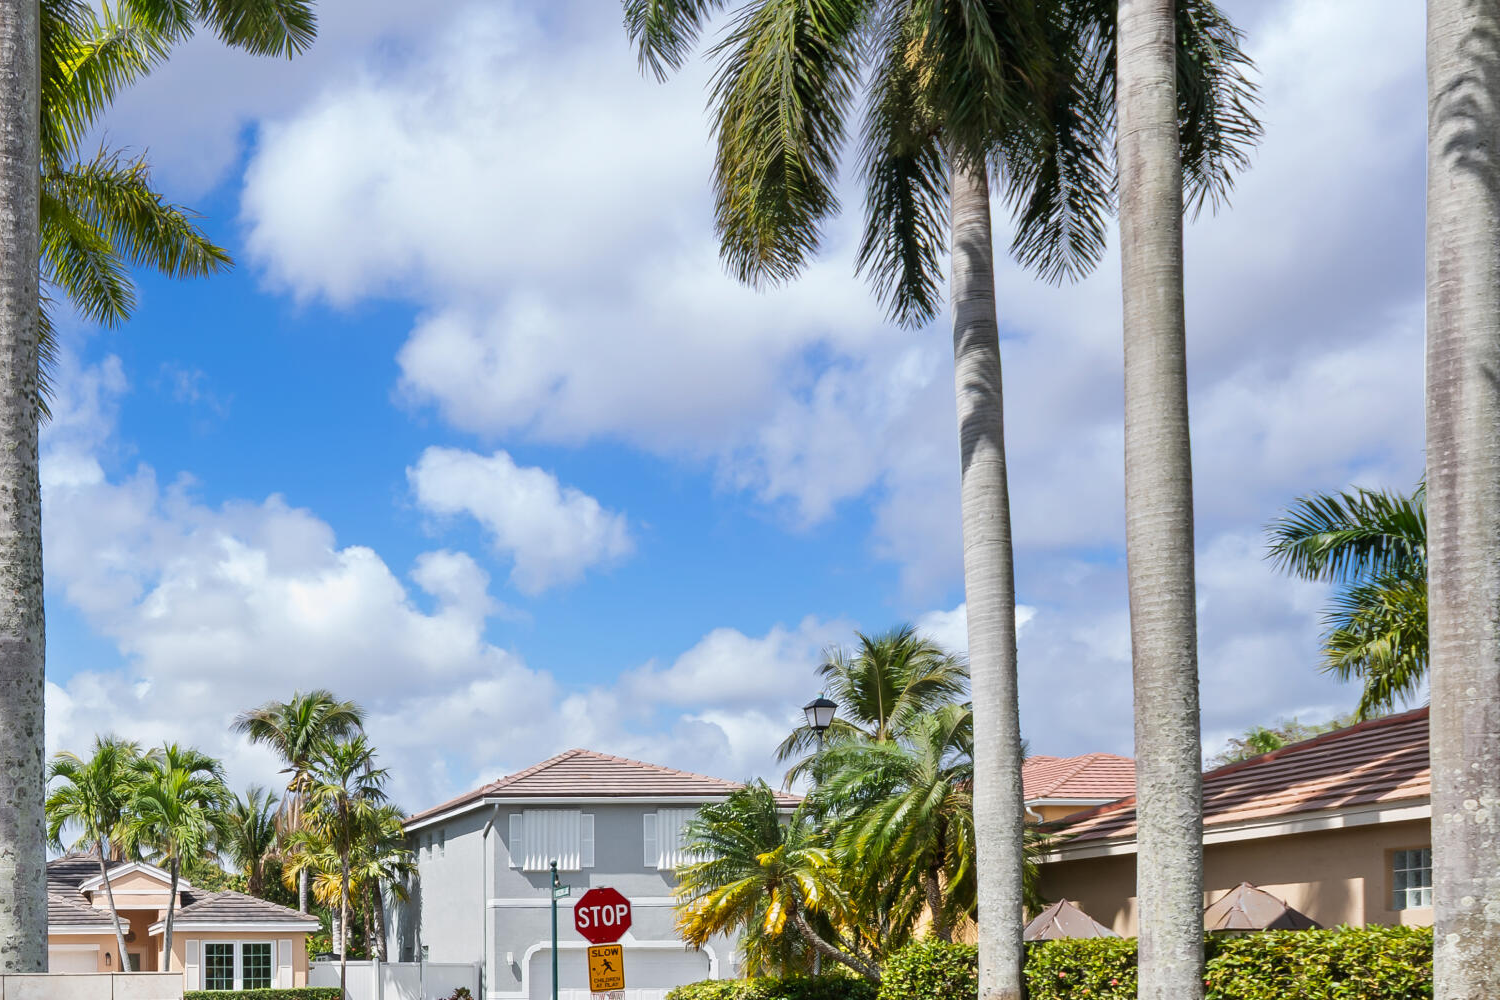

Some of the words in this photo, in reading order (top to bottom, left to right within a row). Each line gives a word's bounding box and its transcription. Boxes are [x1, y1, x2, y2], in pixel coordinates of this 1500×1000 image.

[578, 904, 628, 928] STOP
[592, 948, 619, 958] SLOW
[594, 976, 621, 984] CHILDREN
[593, 993, 606, 1000] TOW
